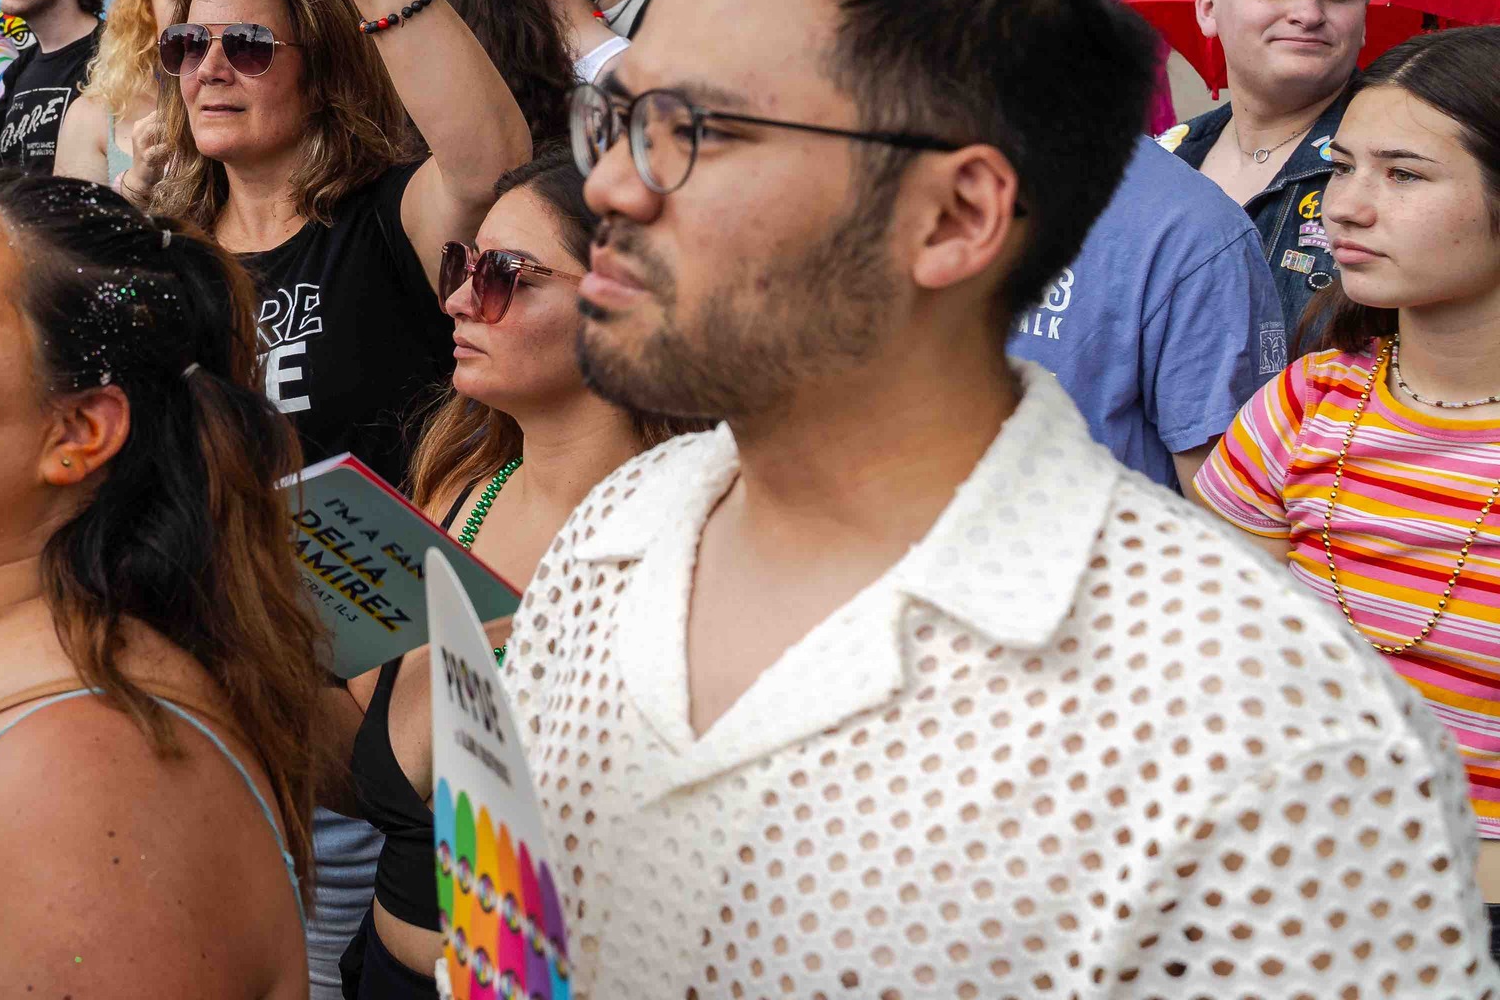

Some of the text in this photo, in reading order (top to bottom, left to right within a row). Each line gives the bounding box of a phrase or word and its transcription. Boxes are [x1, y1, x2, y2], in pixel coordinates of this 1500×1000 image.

[292, 508, 388, 586] DELIA
[323, 497, 363, 526] I'M
[359, 528, 381, 544] A
[295, 539, 413, 632] AMIREZ
